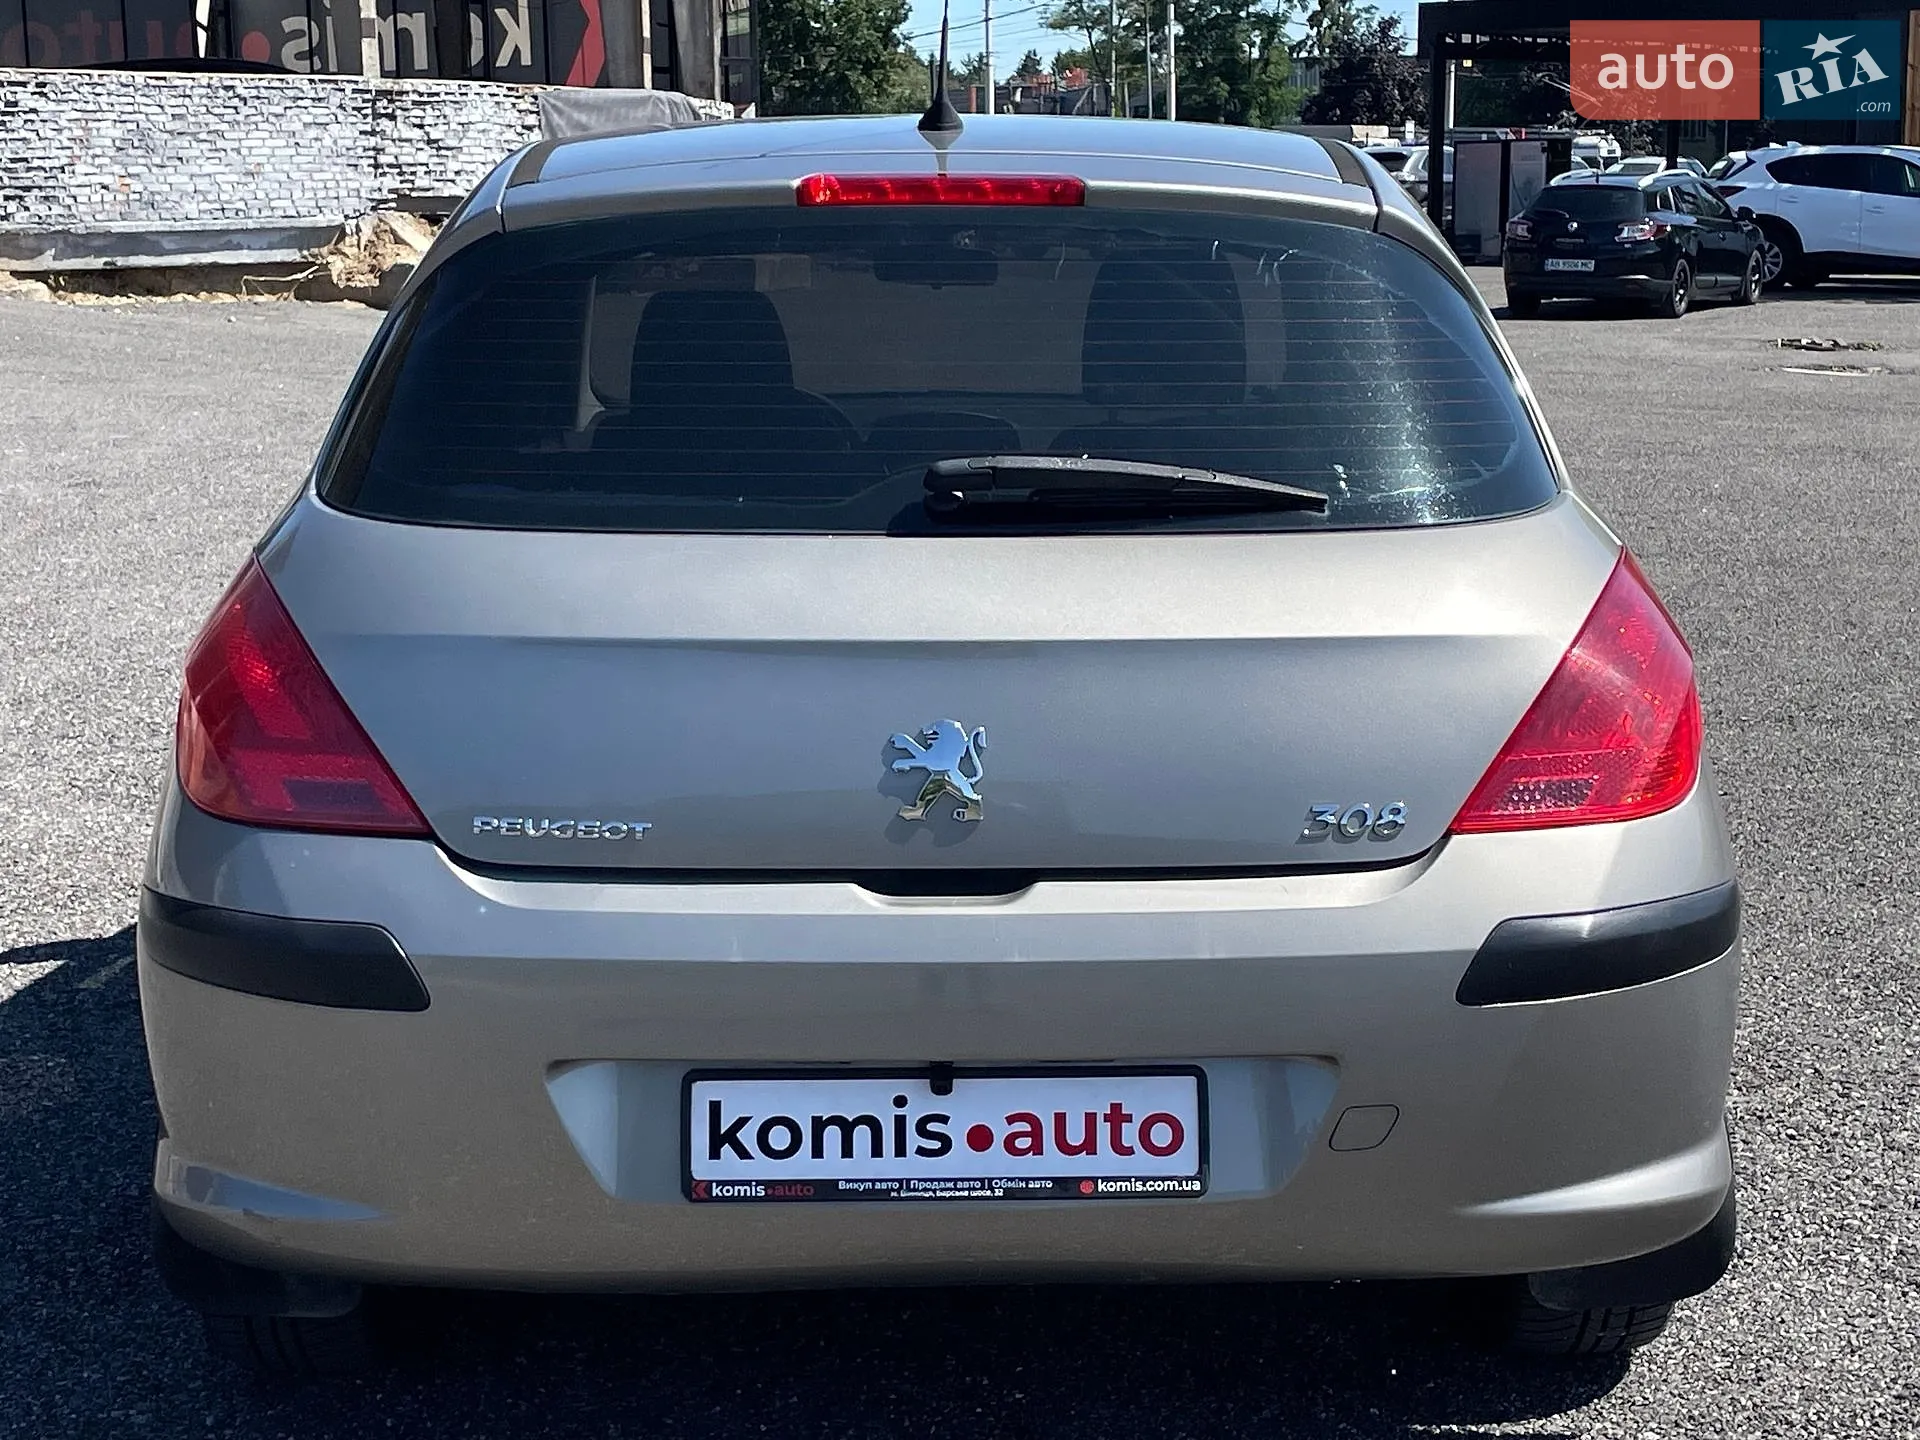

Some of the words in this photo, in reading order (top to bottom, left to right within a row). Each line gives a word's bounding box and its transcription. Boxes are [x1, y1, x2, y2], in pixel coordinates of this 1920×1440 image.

[472, 815, 652, 841] PEUGEOT
[1303, 800, 1408, 838] 308
[838, 1180, 872, 1191] Викуп
[874, 1181, 900, 1190] авто
[910, 1180, 954, 1190] Продаж
[956, 1181, 982, 1189] авто
[992, 1179, 1026, 1188] Обмін
[1028, 1180, 1053, 1188] авто
[1097, 1178, 1201, 1192] komis.com.ua
